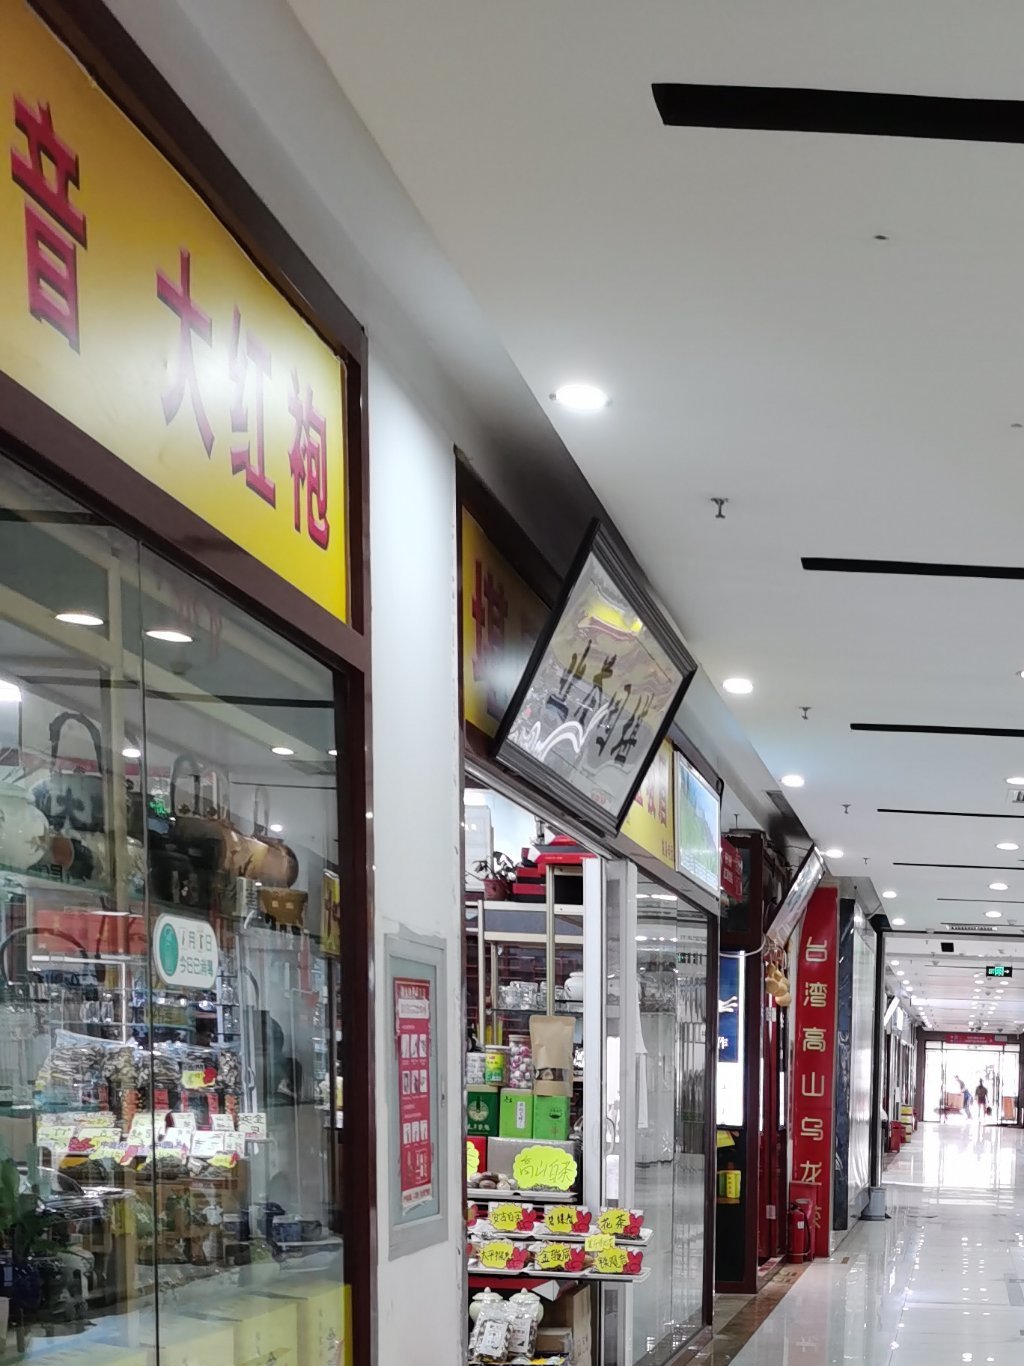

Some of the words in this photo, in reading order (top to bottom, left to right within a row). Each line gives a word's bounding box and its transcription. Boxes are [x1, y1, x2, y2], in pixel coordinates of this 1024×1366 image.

[10, 93, 88, 356] 音
[156, 246, 330, 551] 大红袍
[601, 1213, 627, 1230] 花茶
